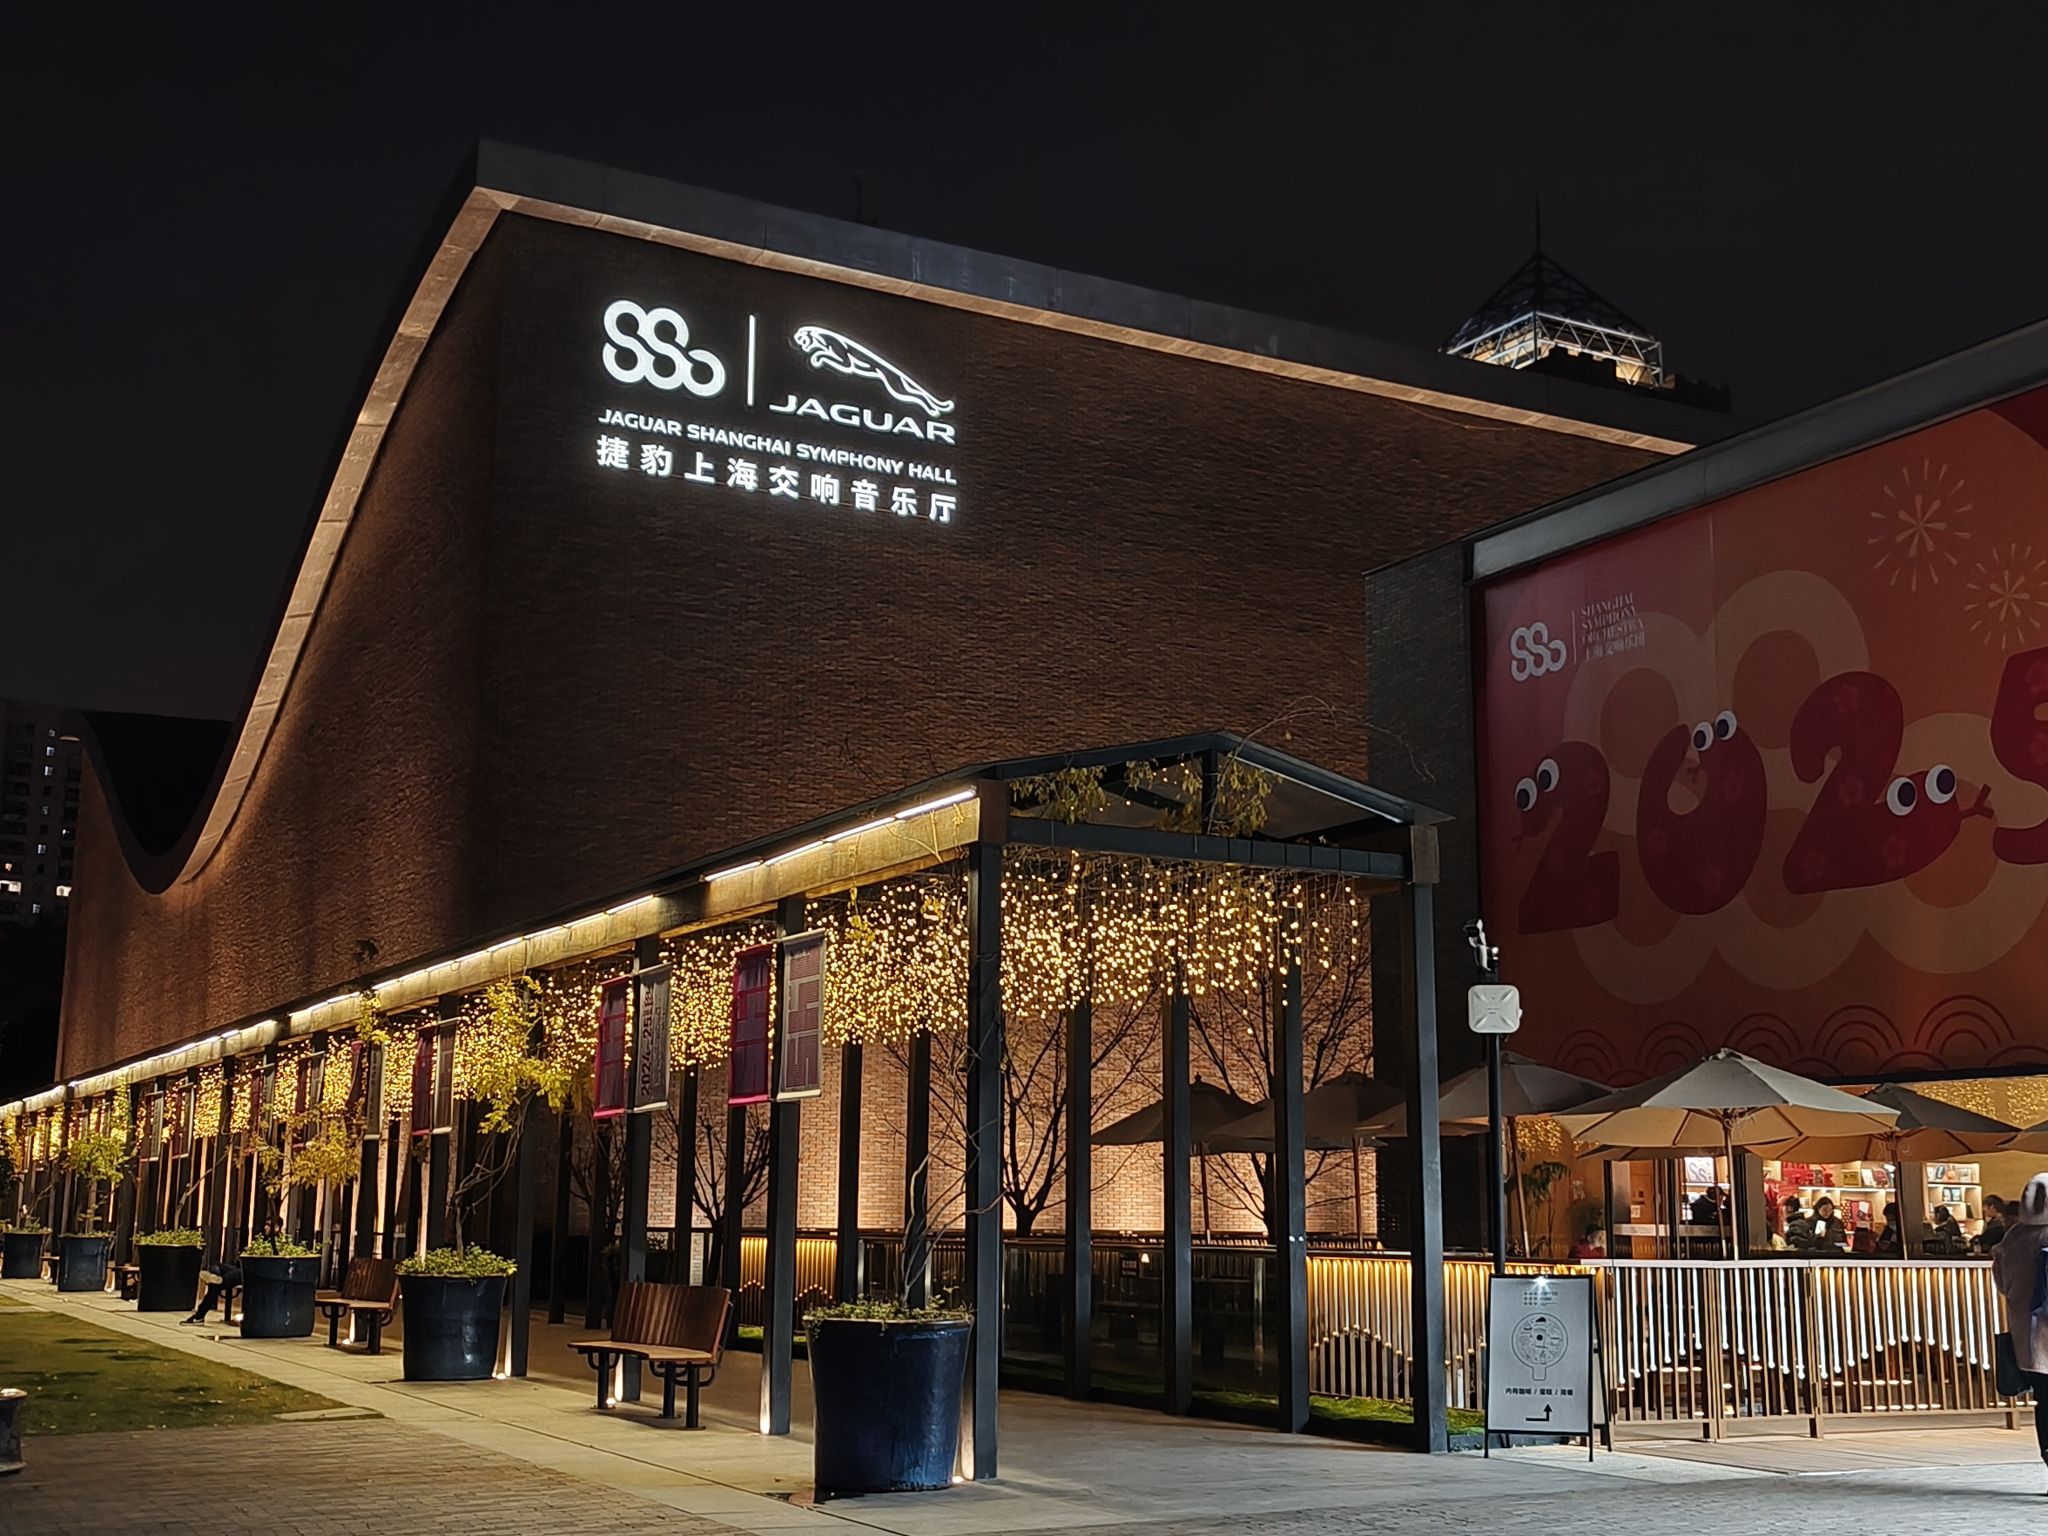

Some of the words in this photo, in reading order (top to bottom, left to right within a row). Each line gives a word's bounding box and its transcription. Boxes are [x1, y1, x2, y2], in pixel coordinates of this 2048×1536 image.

[598, 408, 683, 437] JAGUAR
[686, 423, 792, 456] SHANGHAI
[795, 443, 904, 475] SYMPHONY
[908, 462, 957, 485] HALL
[769, 394, 957, 445] JAGUAR
[595, 434, 957, 524] 捷豹上海交响音乐厅
